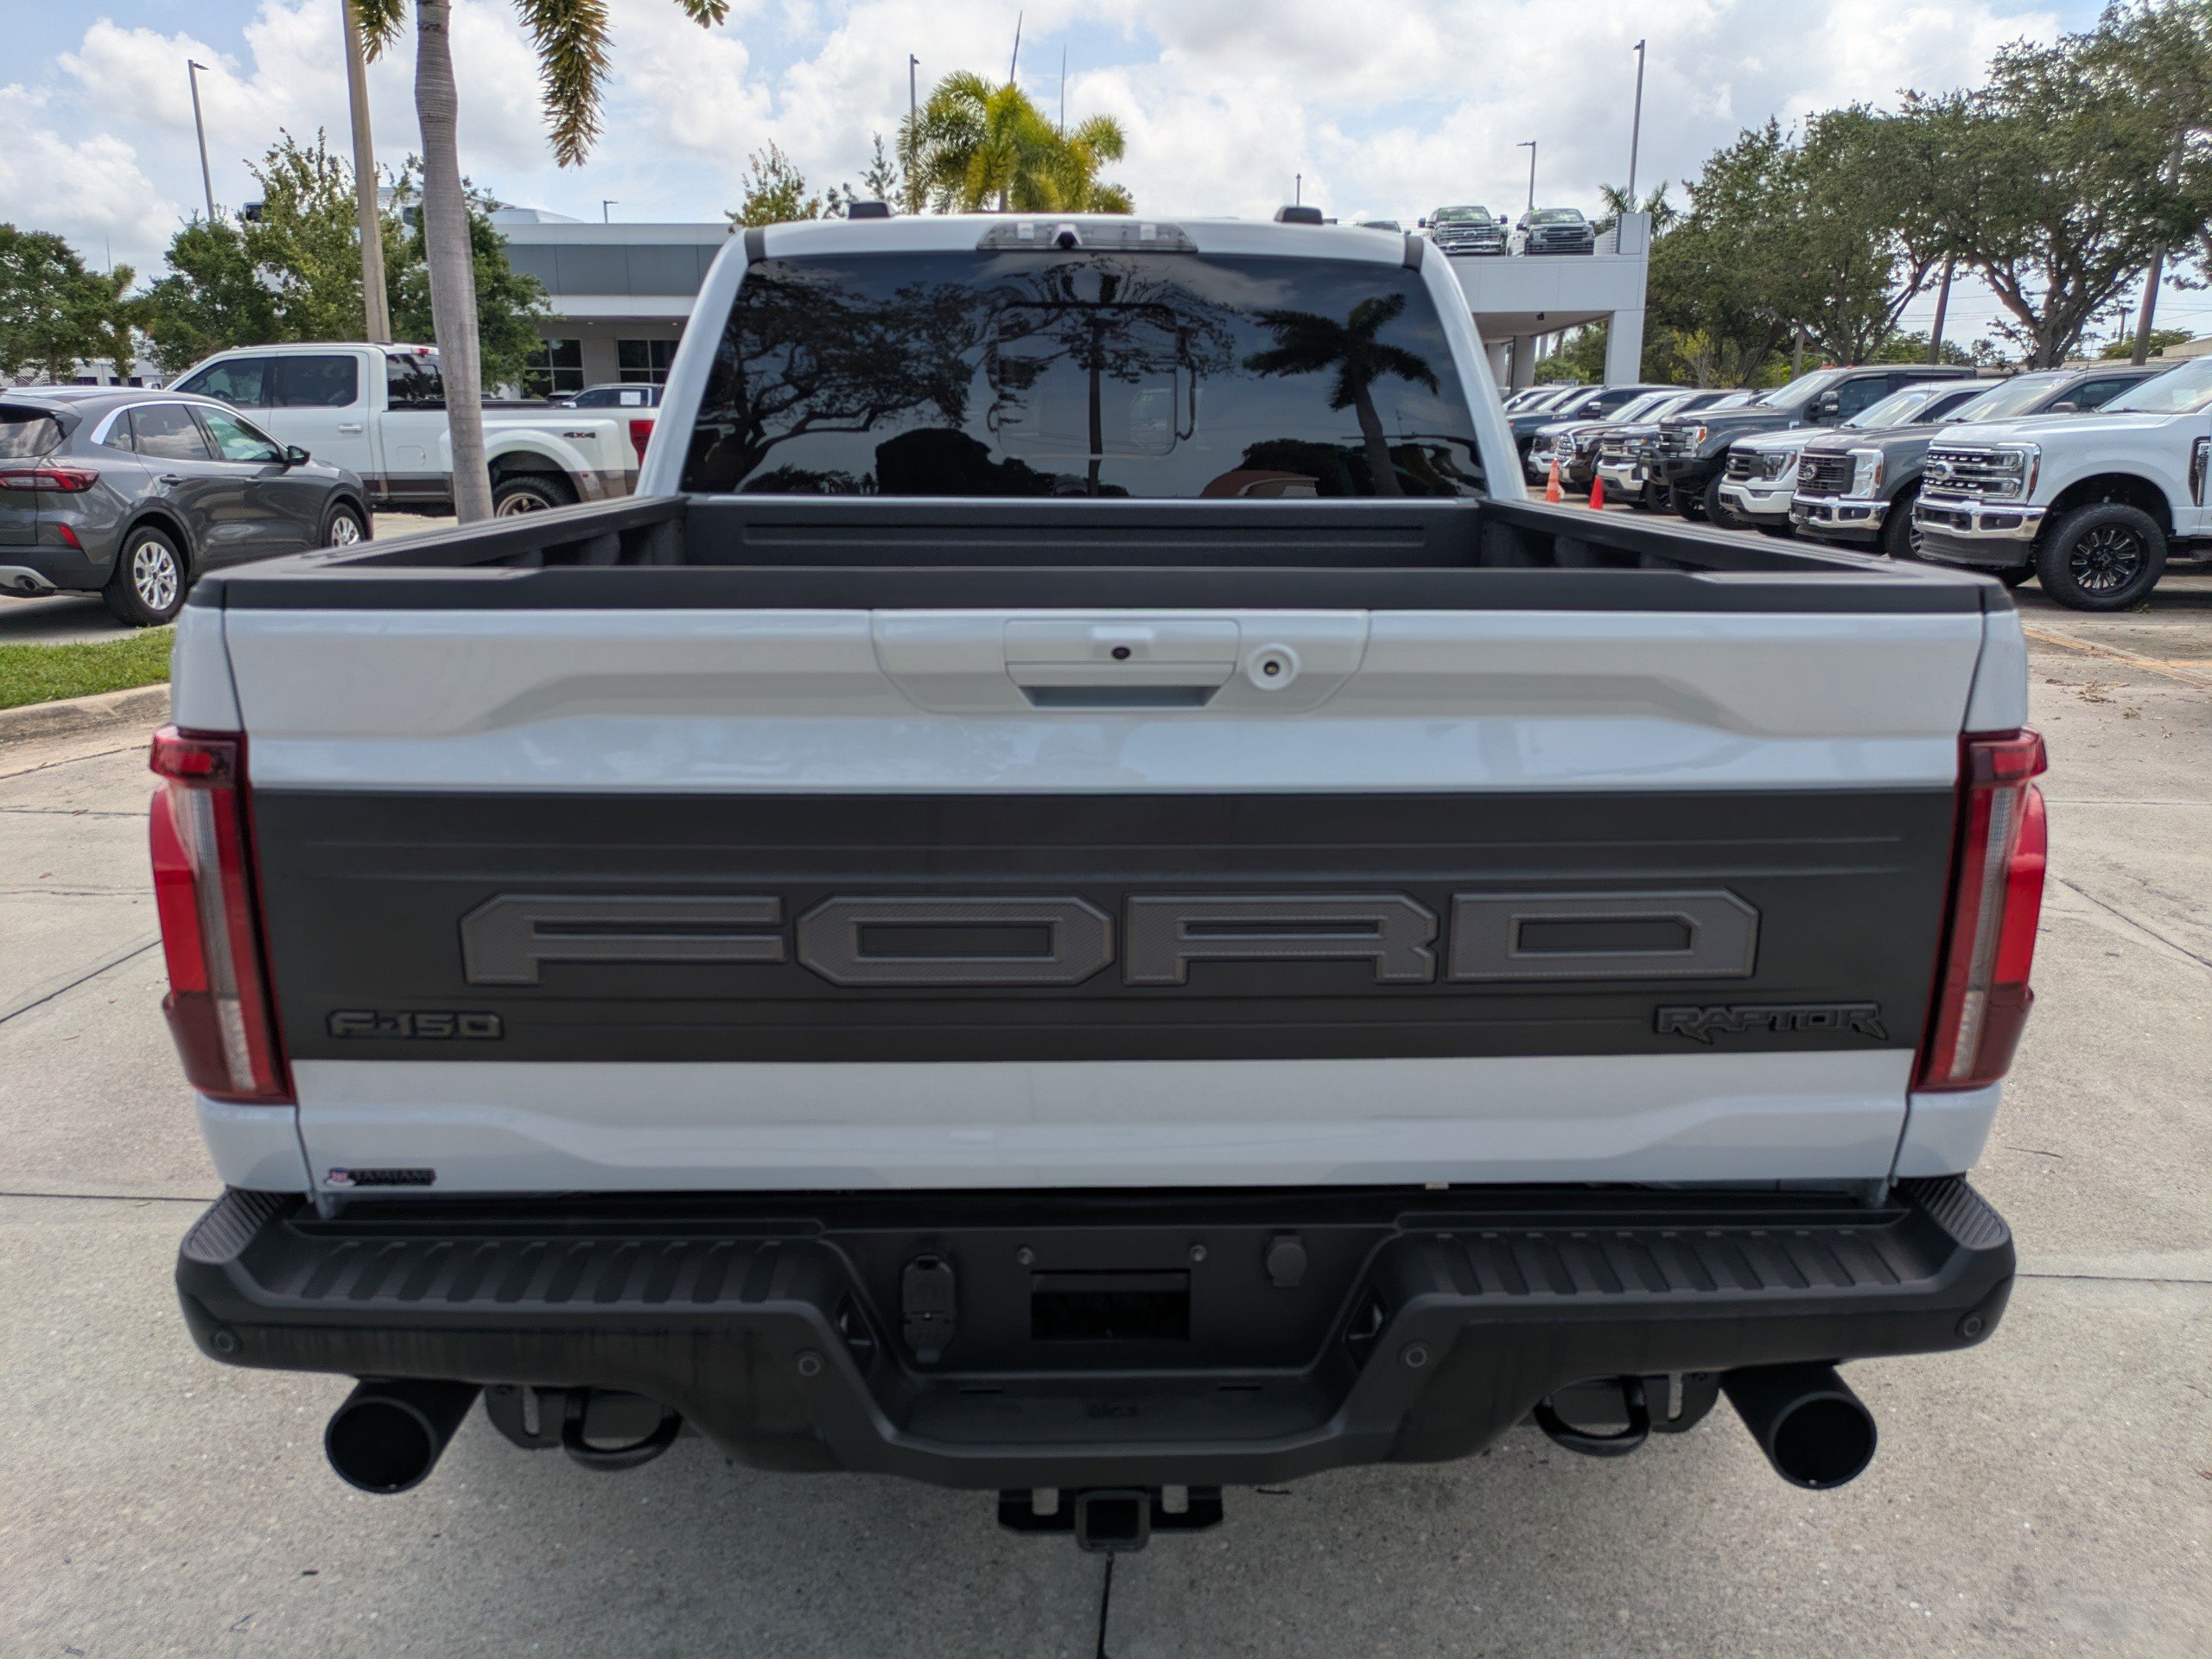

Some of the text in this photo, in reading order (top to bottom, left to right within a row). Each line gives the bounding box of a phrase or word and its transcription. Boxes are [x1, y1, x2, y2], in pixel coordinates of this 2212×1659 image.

[459, 891, 1761, 988] FORD
[327, 1009, 503, 1039] F-150
[1654, 1001, 1888, 1045] RAPTOR
